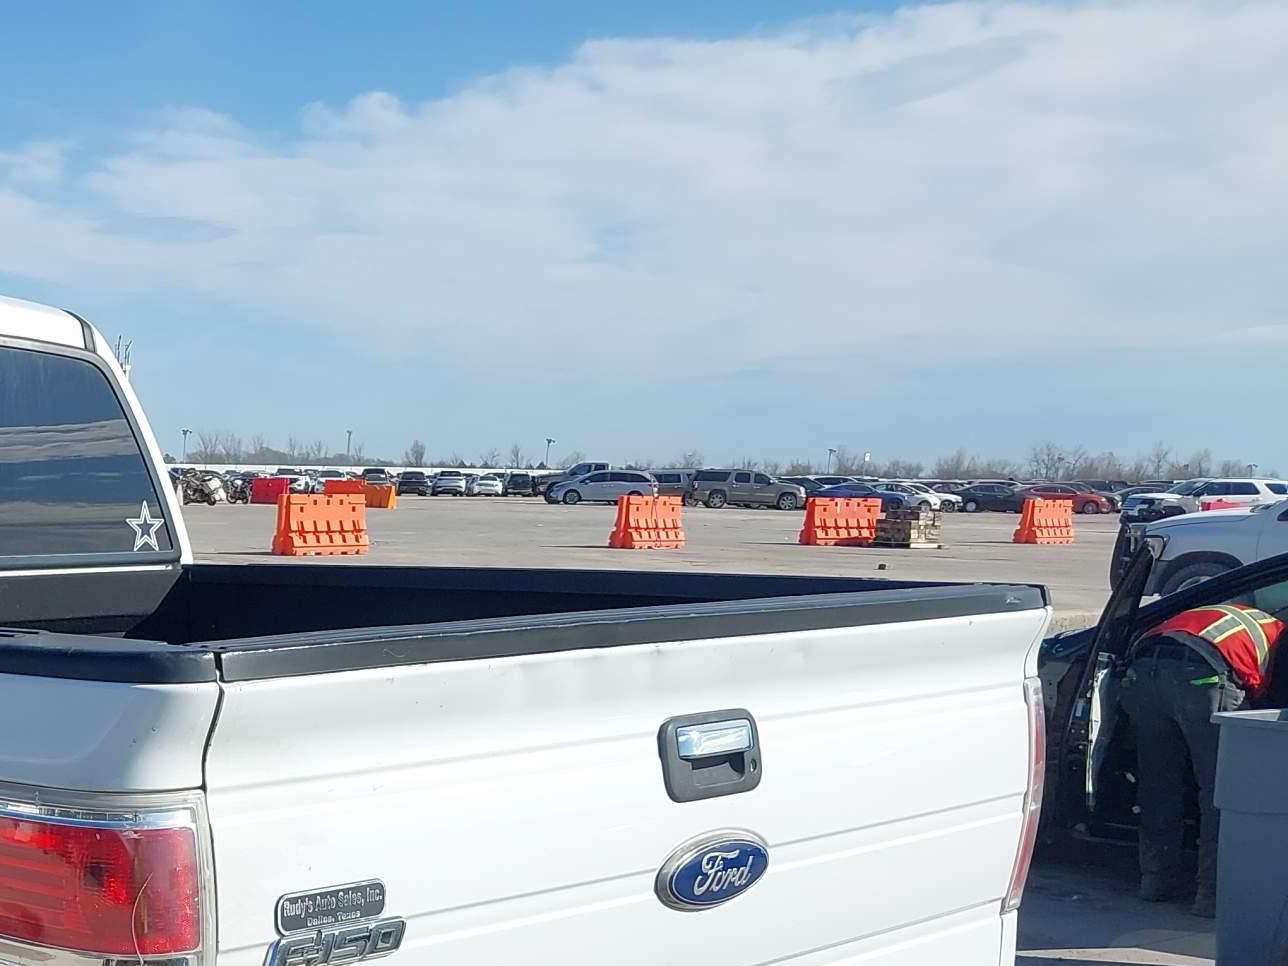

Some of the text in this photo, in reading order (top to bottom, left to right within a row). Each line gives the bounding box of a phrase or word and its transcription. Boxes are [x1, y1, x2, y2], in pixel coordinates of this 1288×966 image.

[693, 849, 754, 895] Ford
[283, 898, 313, 918] Rudy's
[315, 895, 336, 911] Auto
[366, 887, 383, 902] Inc.
